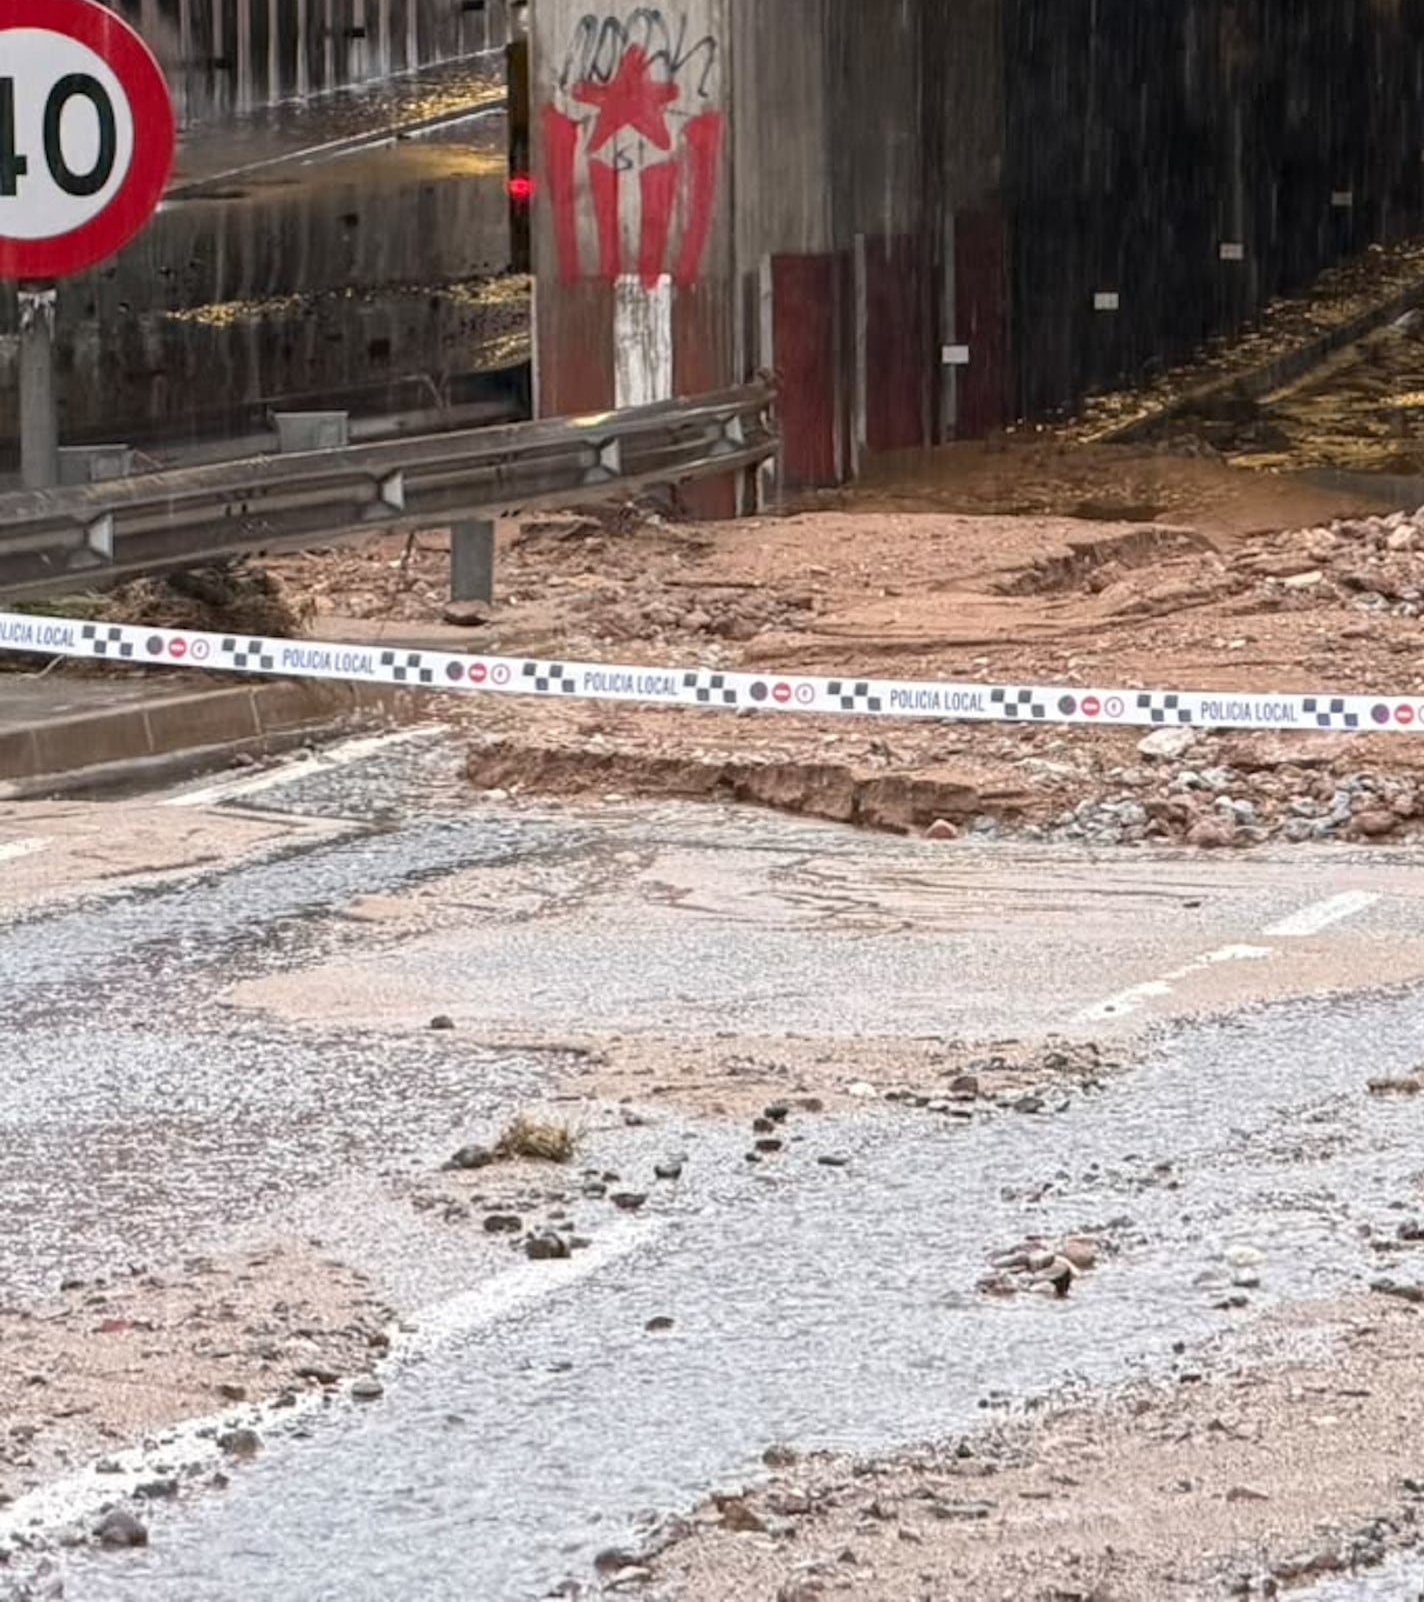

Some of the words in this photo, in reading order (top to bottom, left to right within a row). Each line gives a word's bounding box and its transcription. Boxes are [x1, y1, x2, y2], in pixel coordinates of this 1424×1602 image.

[37, 626, 76, 647] LOCAL
[283, 648, 333, 671] POLICIA
[335, 652, 376, 675] LOCAL
[584, 671, 633, 694] POLICIA
[636, 675, 678, 696] LOCAL
[890, 689, 941, 710] POLICIA
[944, 691, 985, 712] LOCAL
[1201, 700, 1252, 721] POLICIA
[1255, 702, 1298, 723] LOCAL
